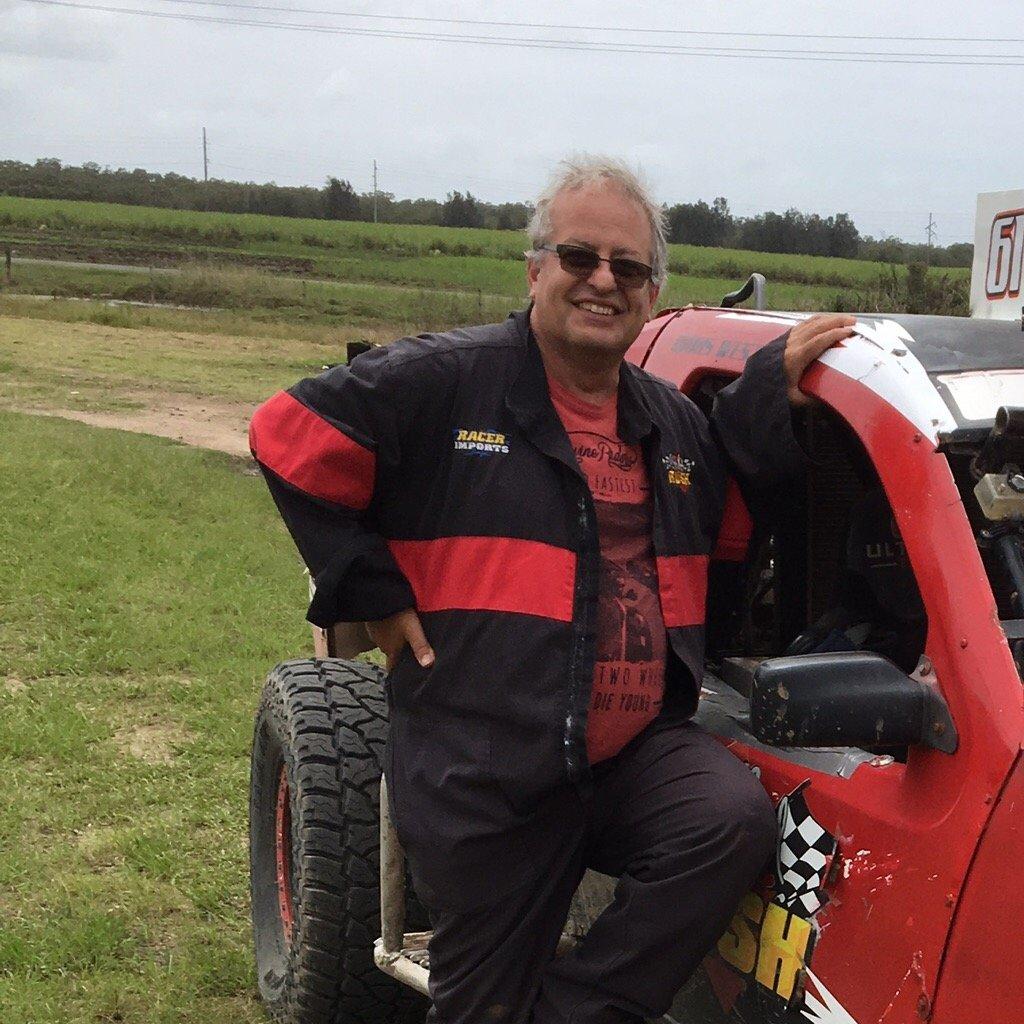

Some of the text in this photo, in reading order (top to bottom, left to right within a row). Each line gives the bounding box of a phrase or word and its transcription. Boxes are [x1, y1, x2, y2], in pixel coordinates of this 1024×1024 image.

[456, 430, 506, 445] RACER
[454, 441, 510, 454] IMPORTS
[599, 665, 631, 686] TWO
